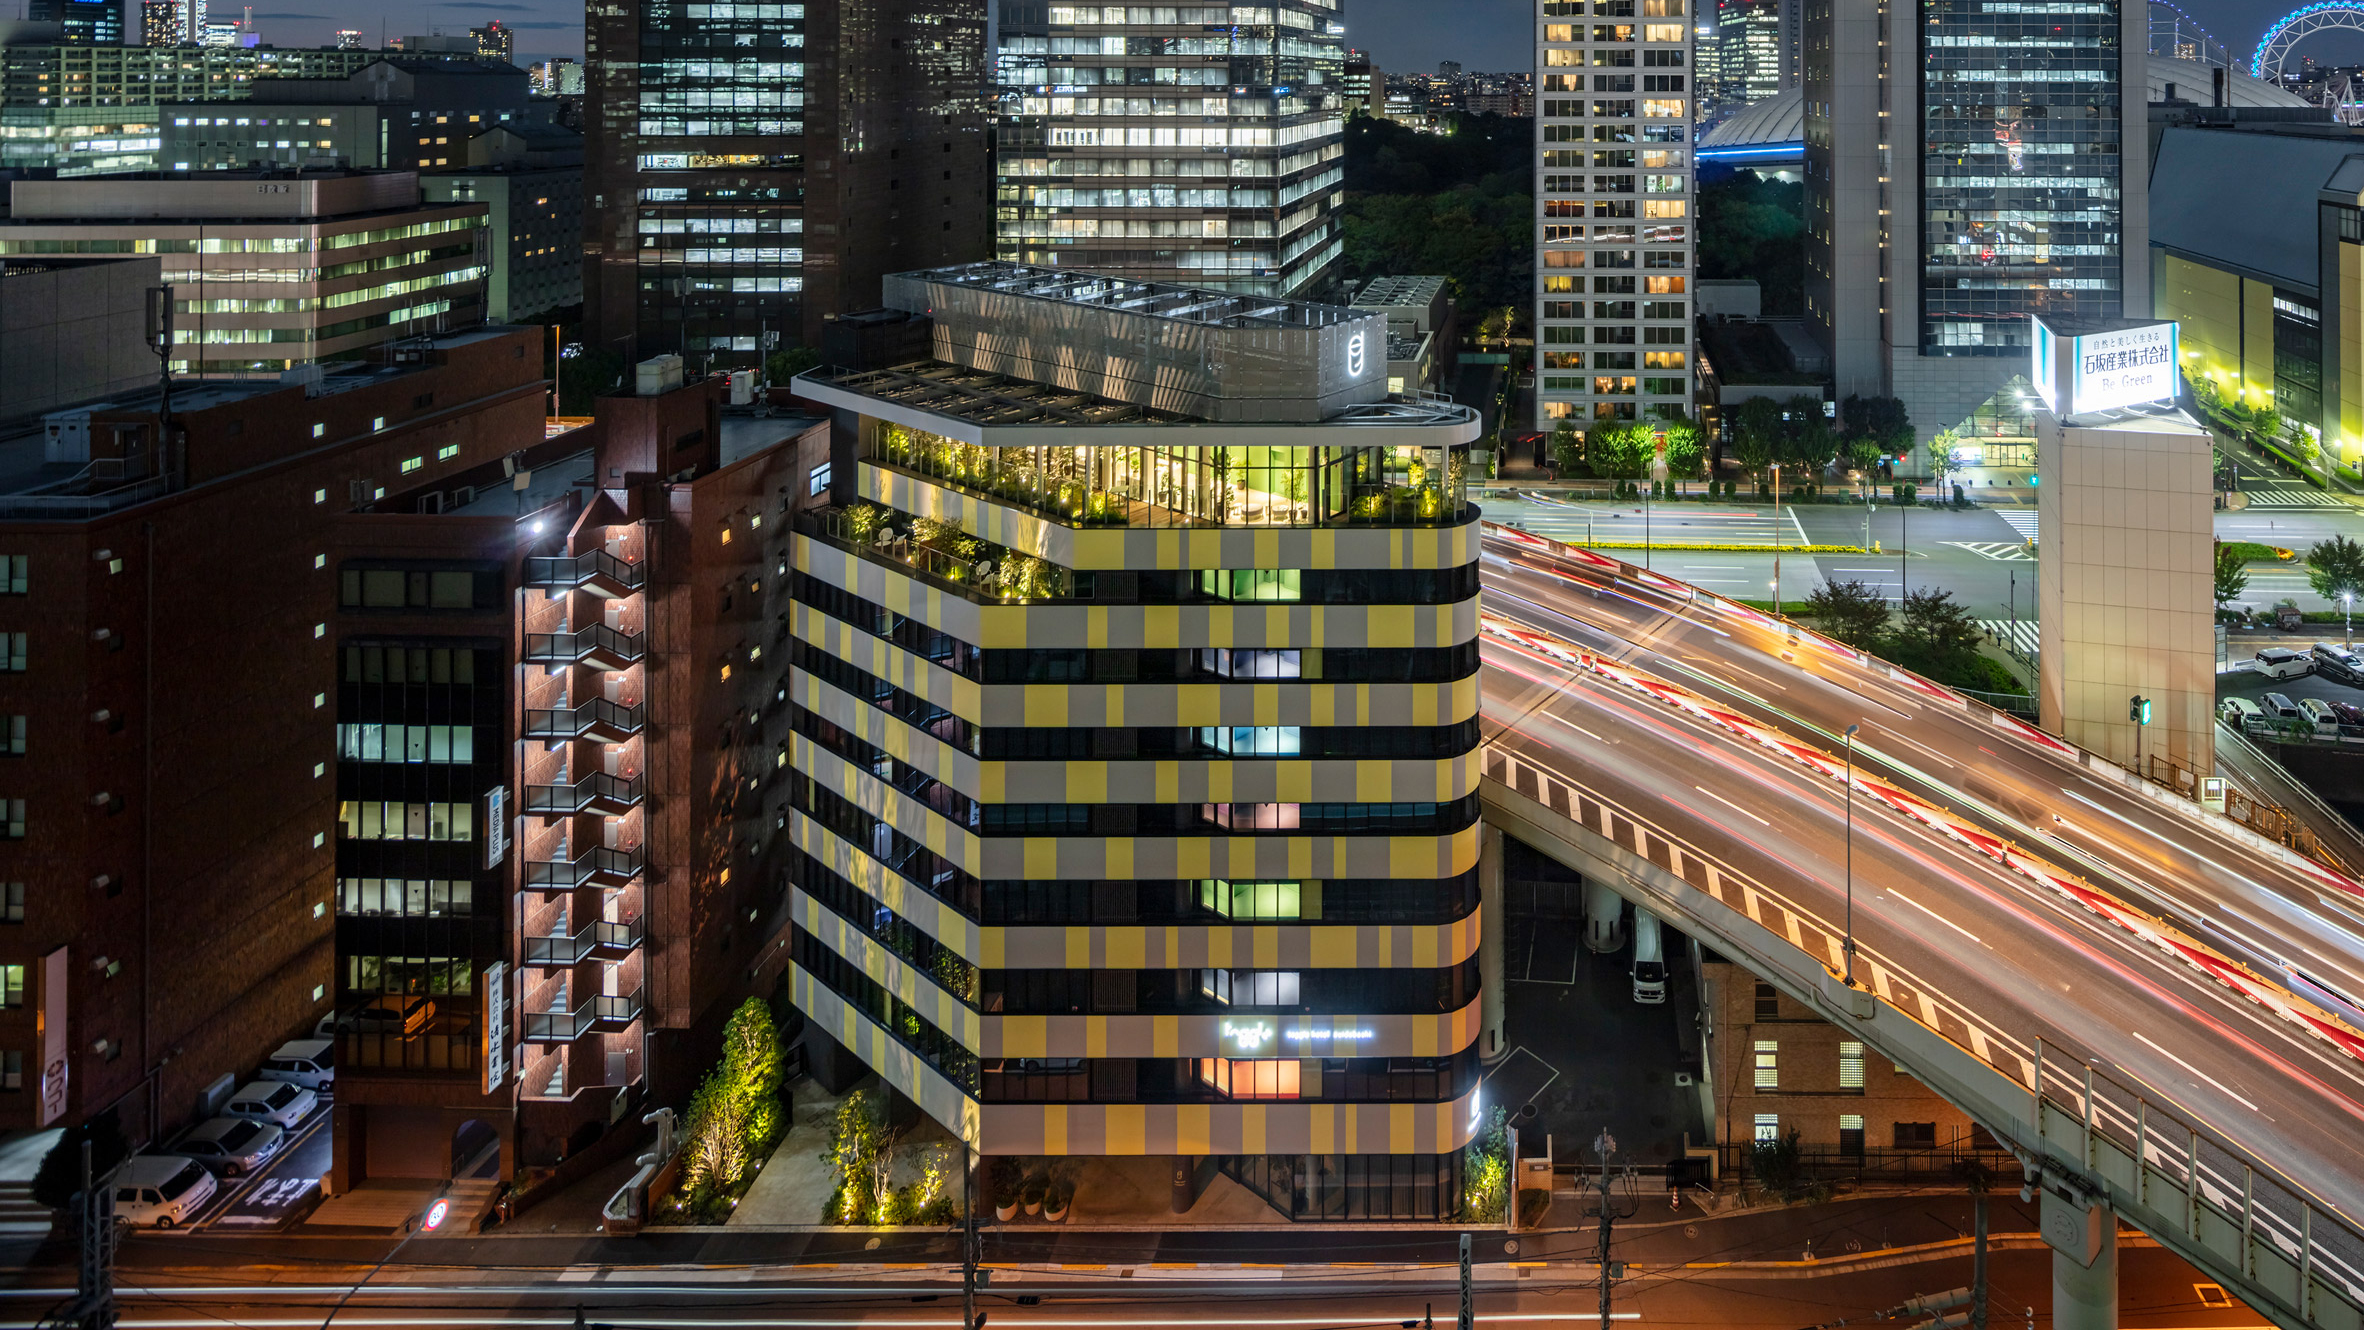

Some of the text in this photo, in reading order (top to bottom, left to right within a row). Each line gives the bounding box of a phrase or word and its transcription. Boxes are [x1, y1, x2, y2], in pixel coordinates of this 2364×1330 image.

[2093, 332, 2160, 350] 自然と美しく生きる
[2083, 344, 2170, 375] 石坂産業株式会社
[2102, 373, 2153, 391] Be Green
